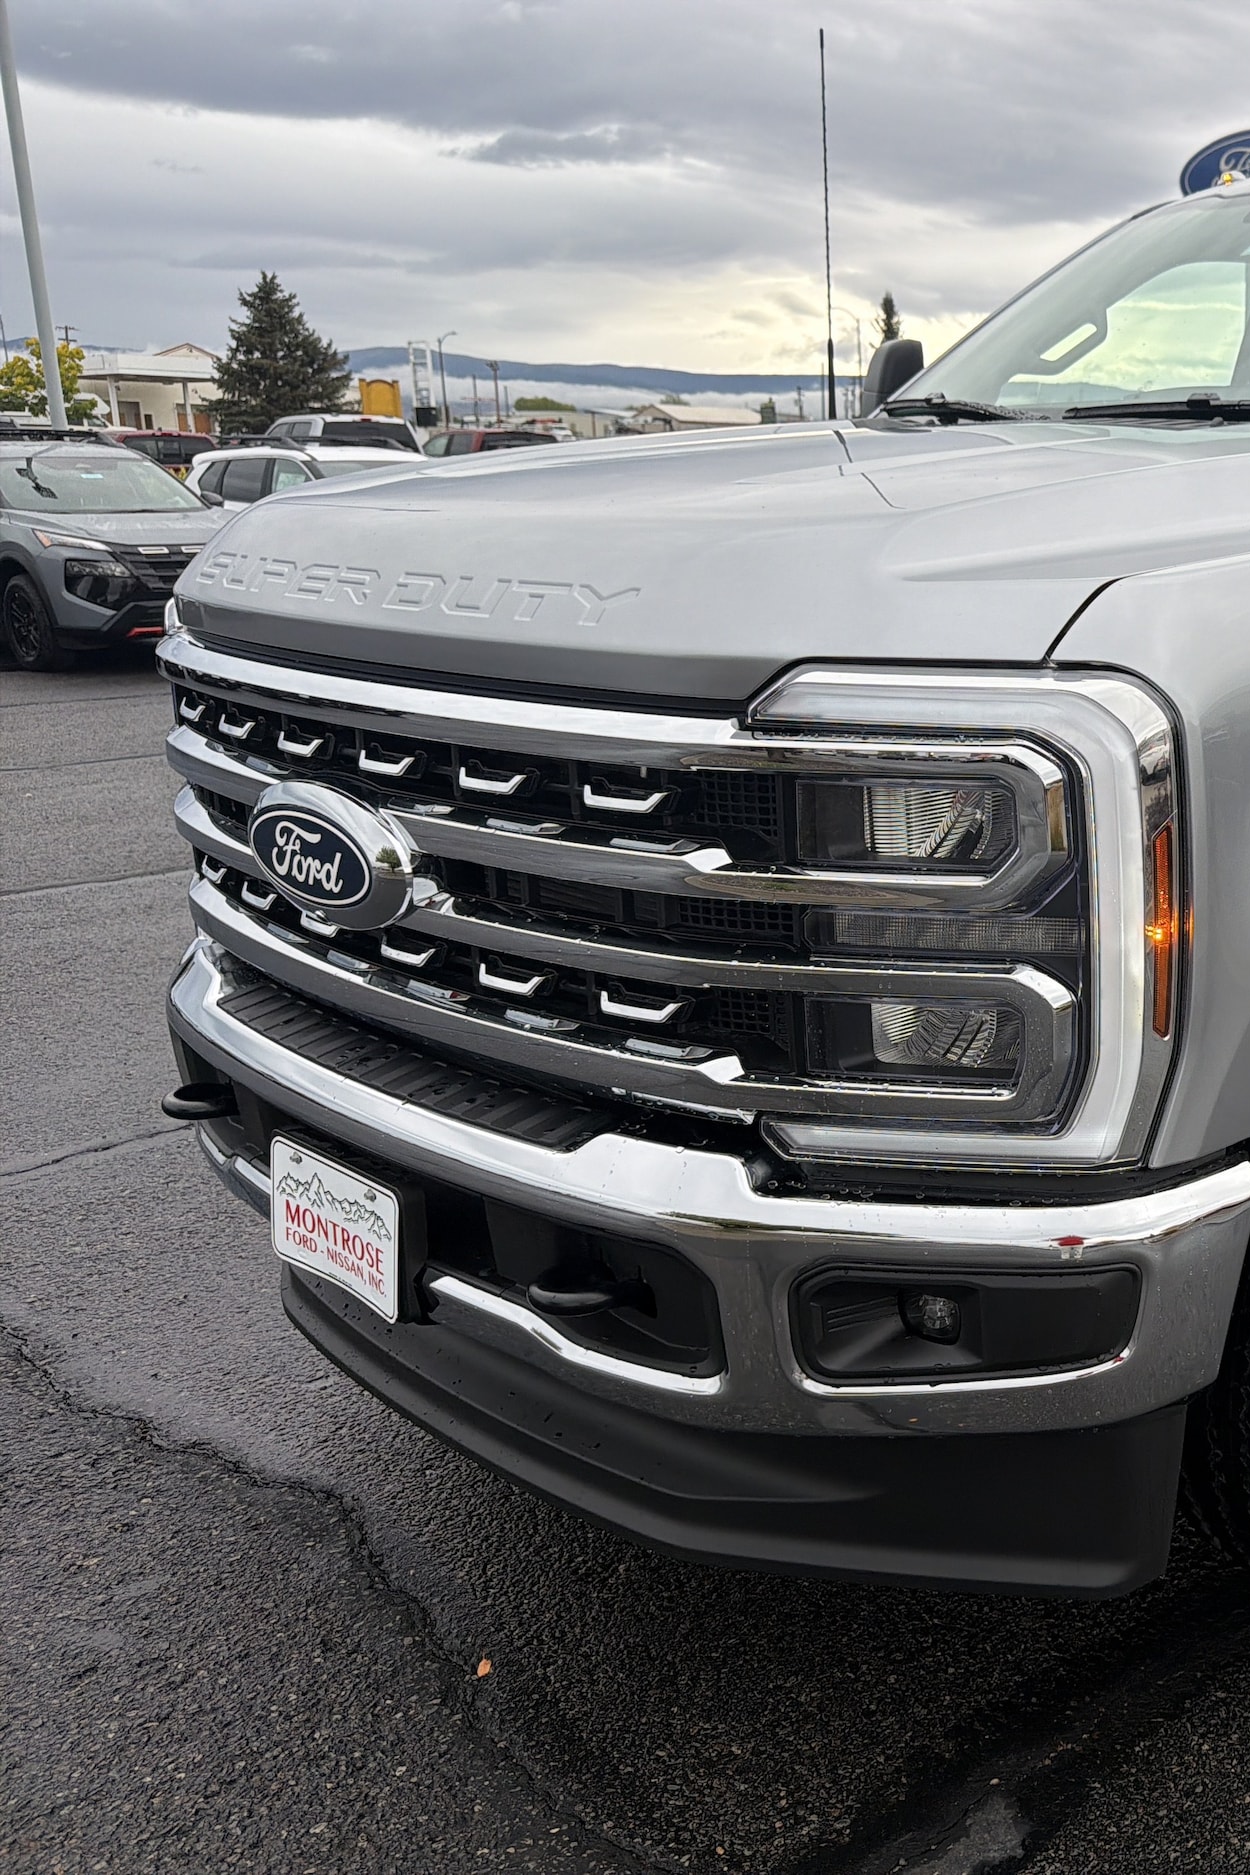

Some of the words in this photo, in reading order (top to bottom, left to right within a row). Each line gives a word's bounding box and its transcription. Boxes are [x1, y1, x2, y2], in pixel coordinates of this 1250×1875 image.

[196, 551, 381, 605] SUPER
[382, 571, 641, 626] DUTY
[271, 820, 344, 894] Ford
[285, 1199, 385, 1276] MONTROSE
[285, 1227, 318, 1254] FORD
[326, 1249, 367, 1286] NISSAN,
[368, 1270, 388, 1298] INC.
